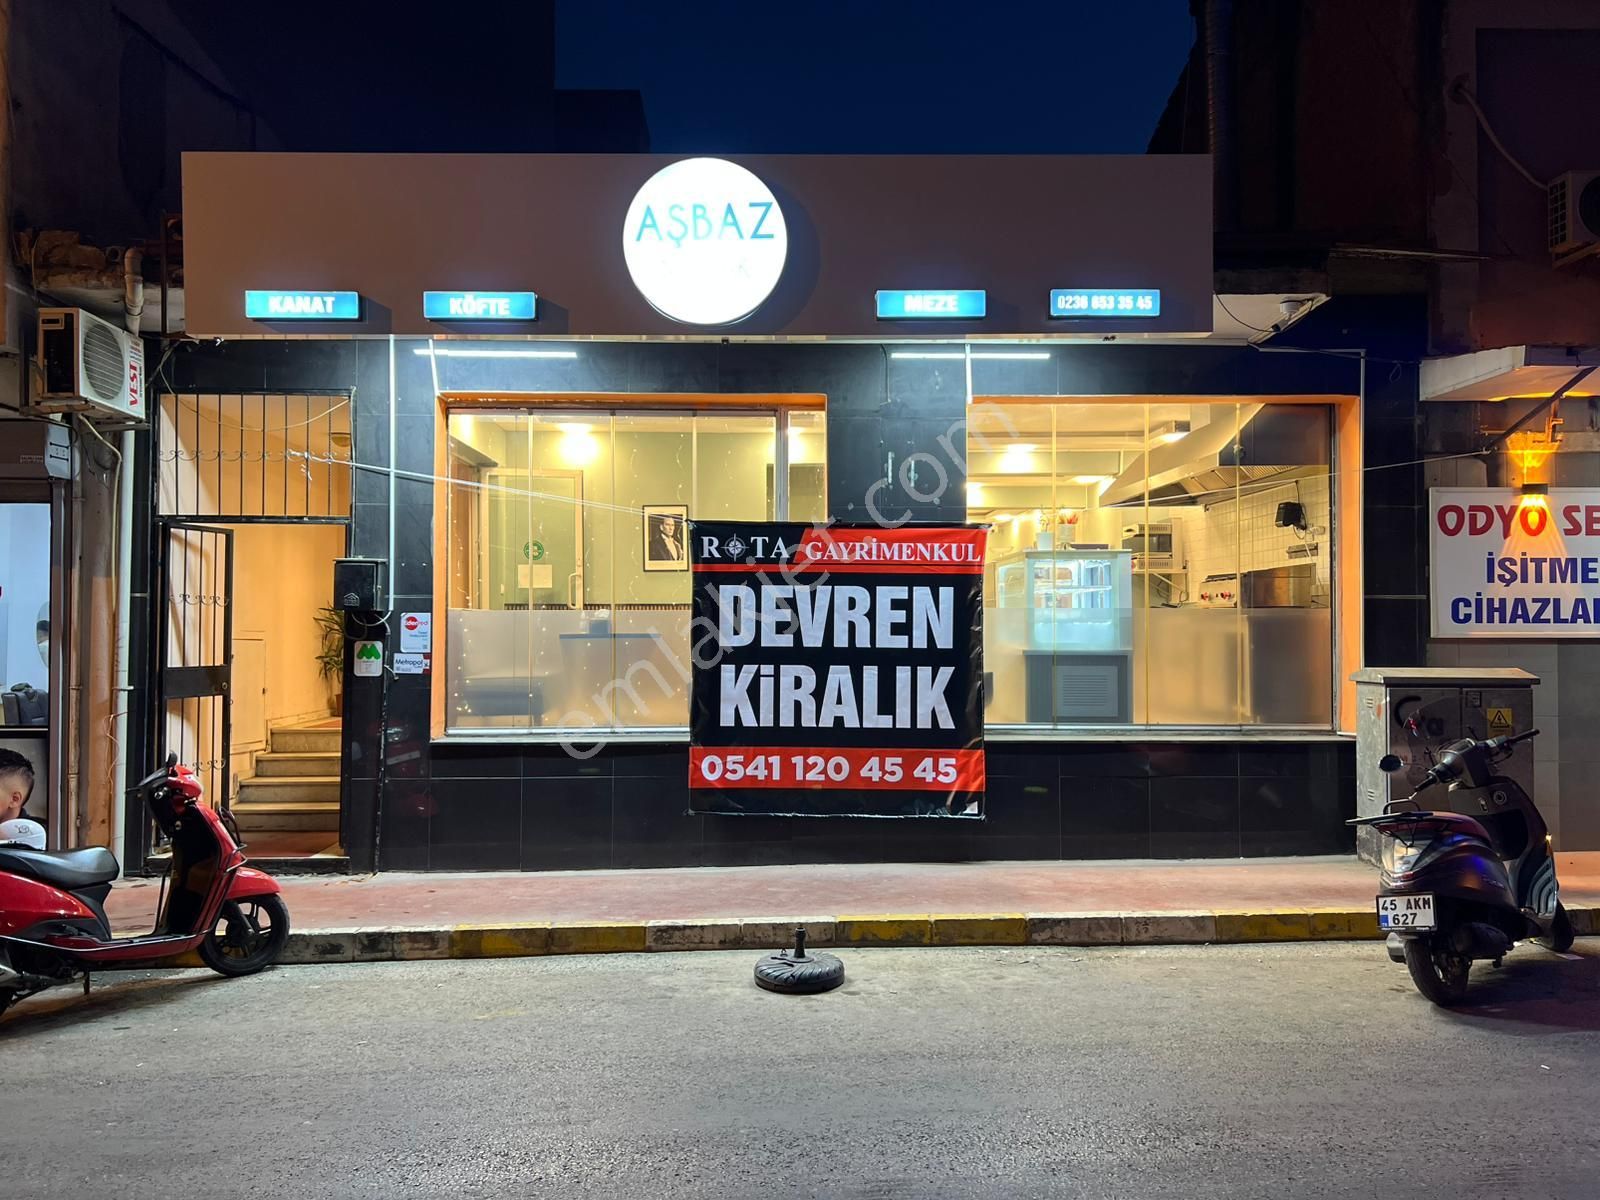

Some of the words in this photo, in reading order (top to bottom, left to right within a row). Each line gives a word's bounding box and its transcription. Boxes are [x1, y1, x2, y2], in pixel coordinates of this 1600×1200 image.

[636, 202, 774, 248] AŞBAZ
[268, 296, 335, 313] KANAT
[449, 293, 510, 315] KÖFTE
[1136, 295, 1153, 310] 45
[1437, 504, 1547, 540] ODYO
[805, 537, 980, 562] GAYRİMENKUL
[1486, 552, 1599, 587] İŞİTME
[718, 584, 954, 649] DEVREN
[701, 755, 781, 781] 0541
[791, 755, 849, 781] 120
[860, 756, 903, 782] 45
[913, 757, 957, 783] 45
[1381, 899, 1397, 911] 45
[1406, 898, 1431, 910] AKM
[1392, 913, 1418, 925] 627
